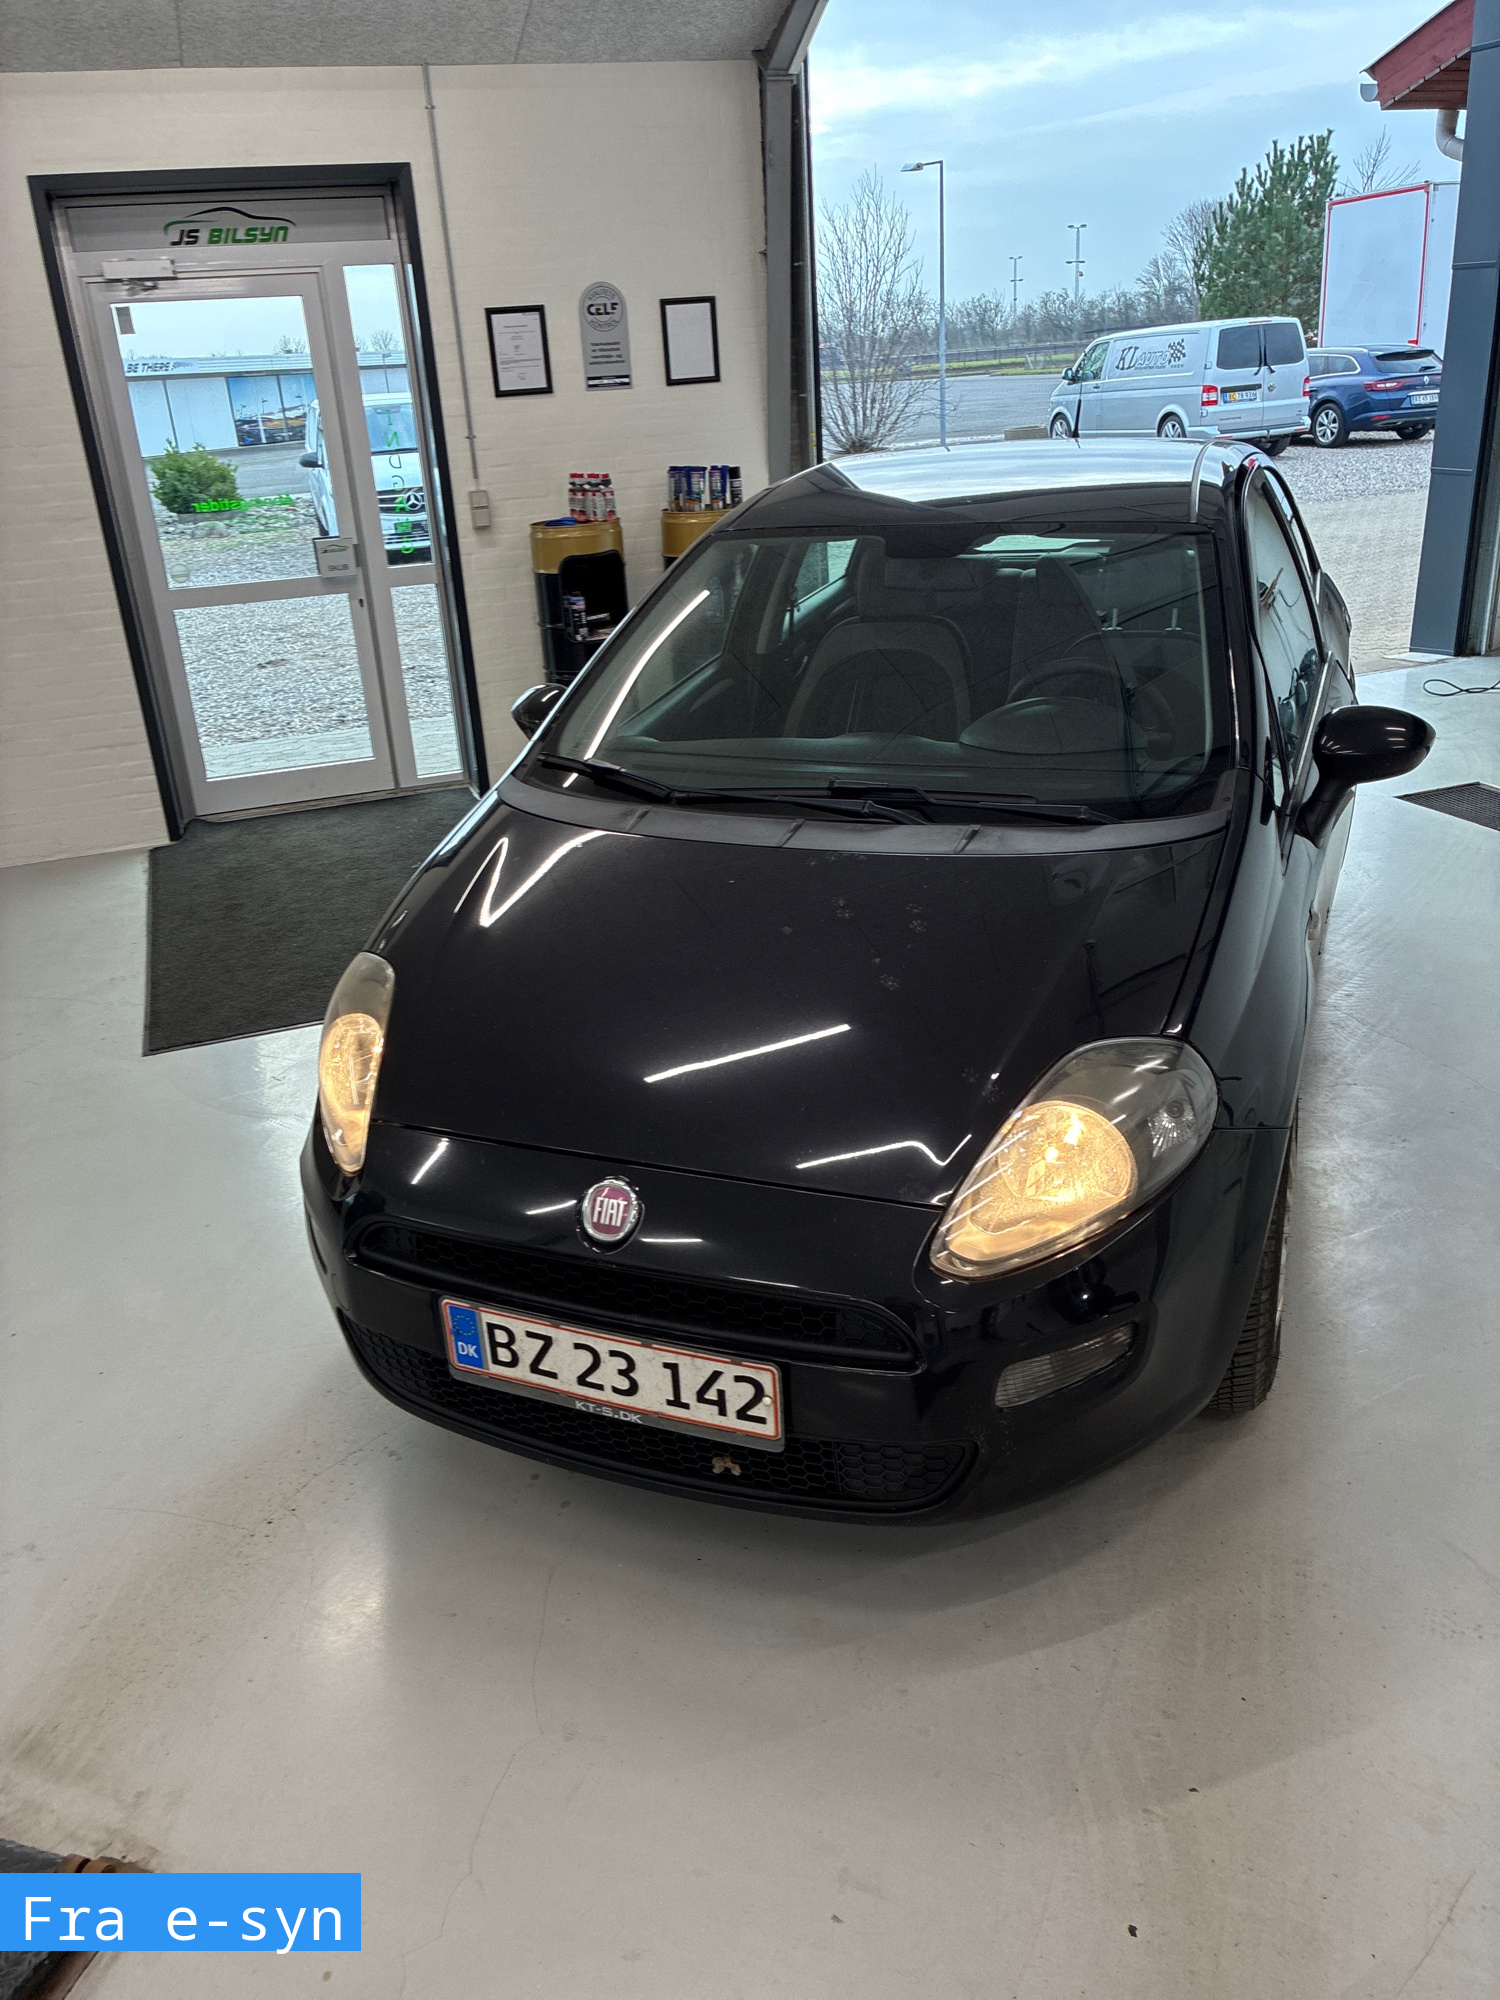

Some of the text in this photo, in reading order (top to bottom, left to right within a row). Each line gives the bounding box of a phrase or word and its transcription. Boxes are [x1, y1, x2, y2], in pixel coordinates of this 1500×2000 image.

[170, 226, 289, 246] JS BILSYN
[587, 302, 619, 316] CELF
[126, 362, 171, 373] BE THERE
[1115, 345, 1171, 371] KL AUTO
[592, 1196, 629, 1227] FIAT
[457, 1341, 479, 1360] DK
[485, 1321, 768, 1425] BZ 23 142
